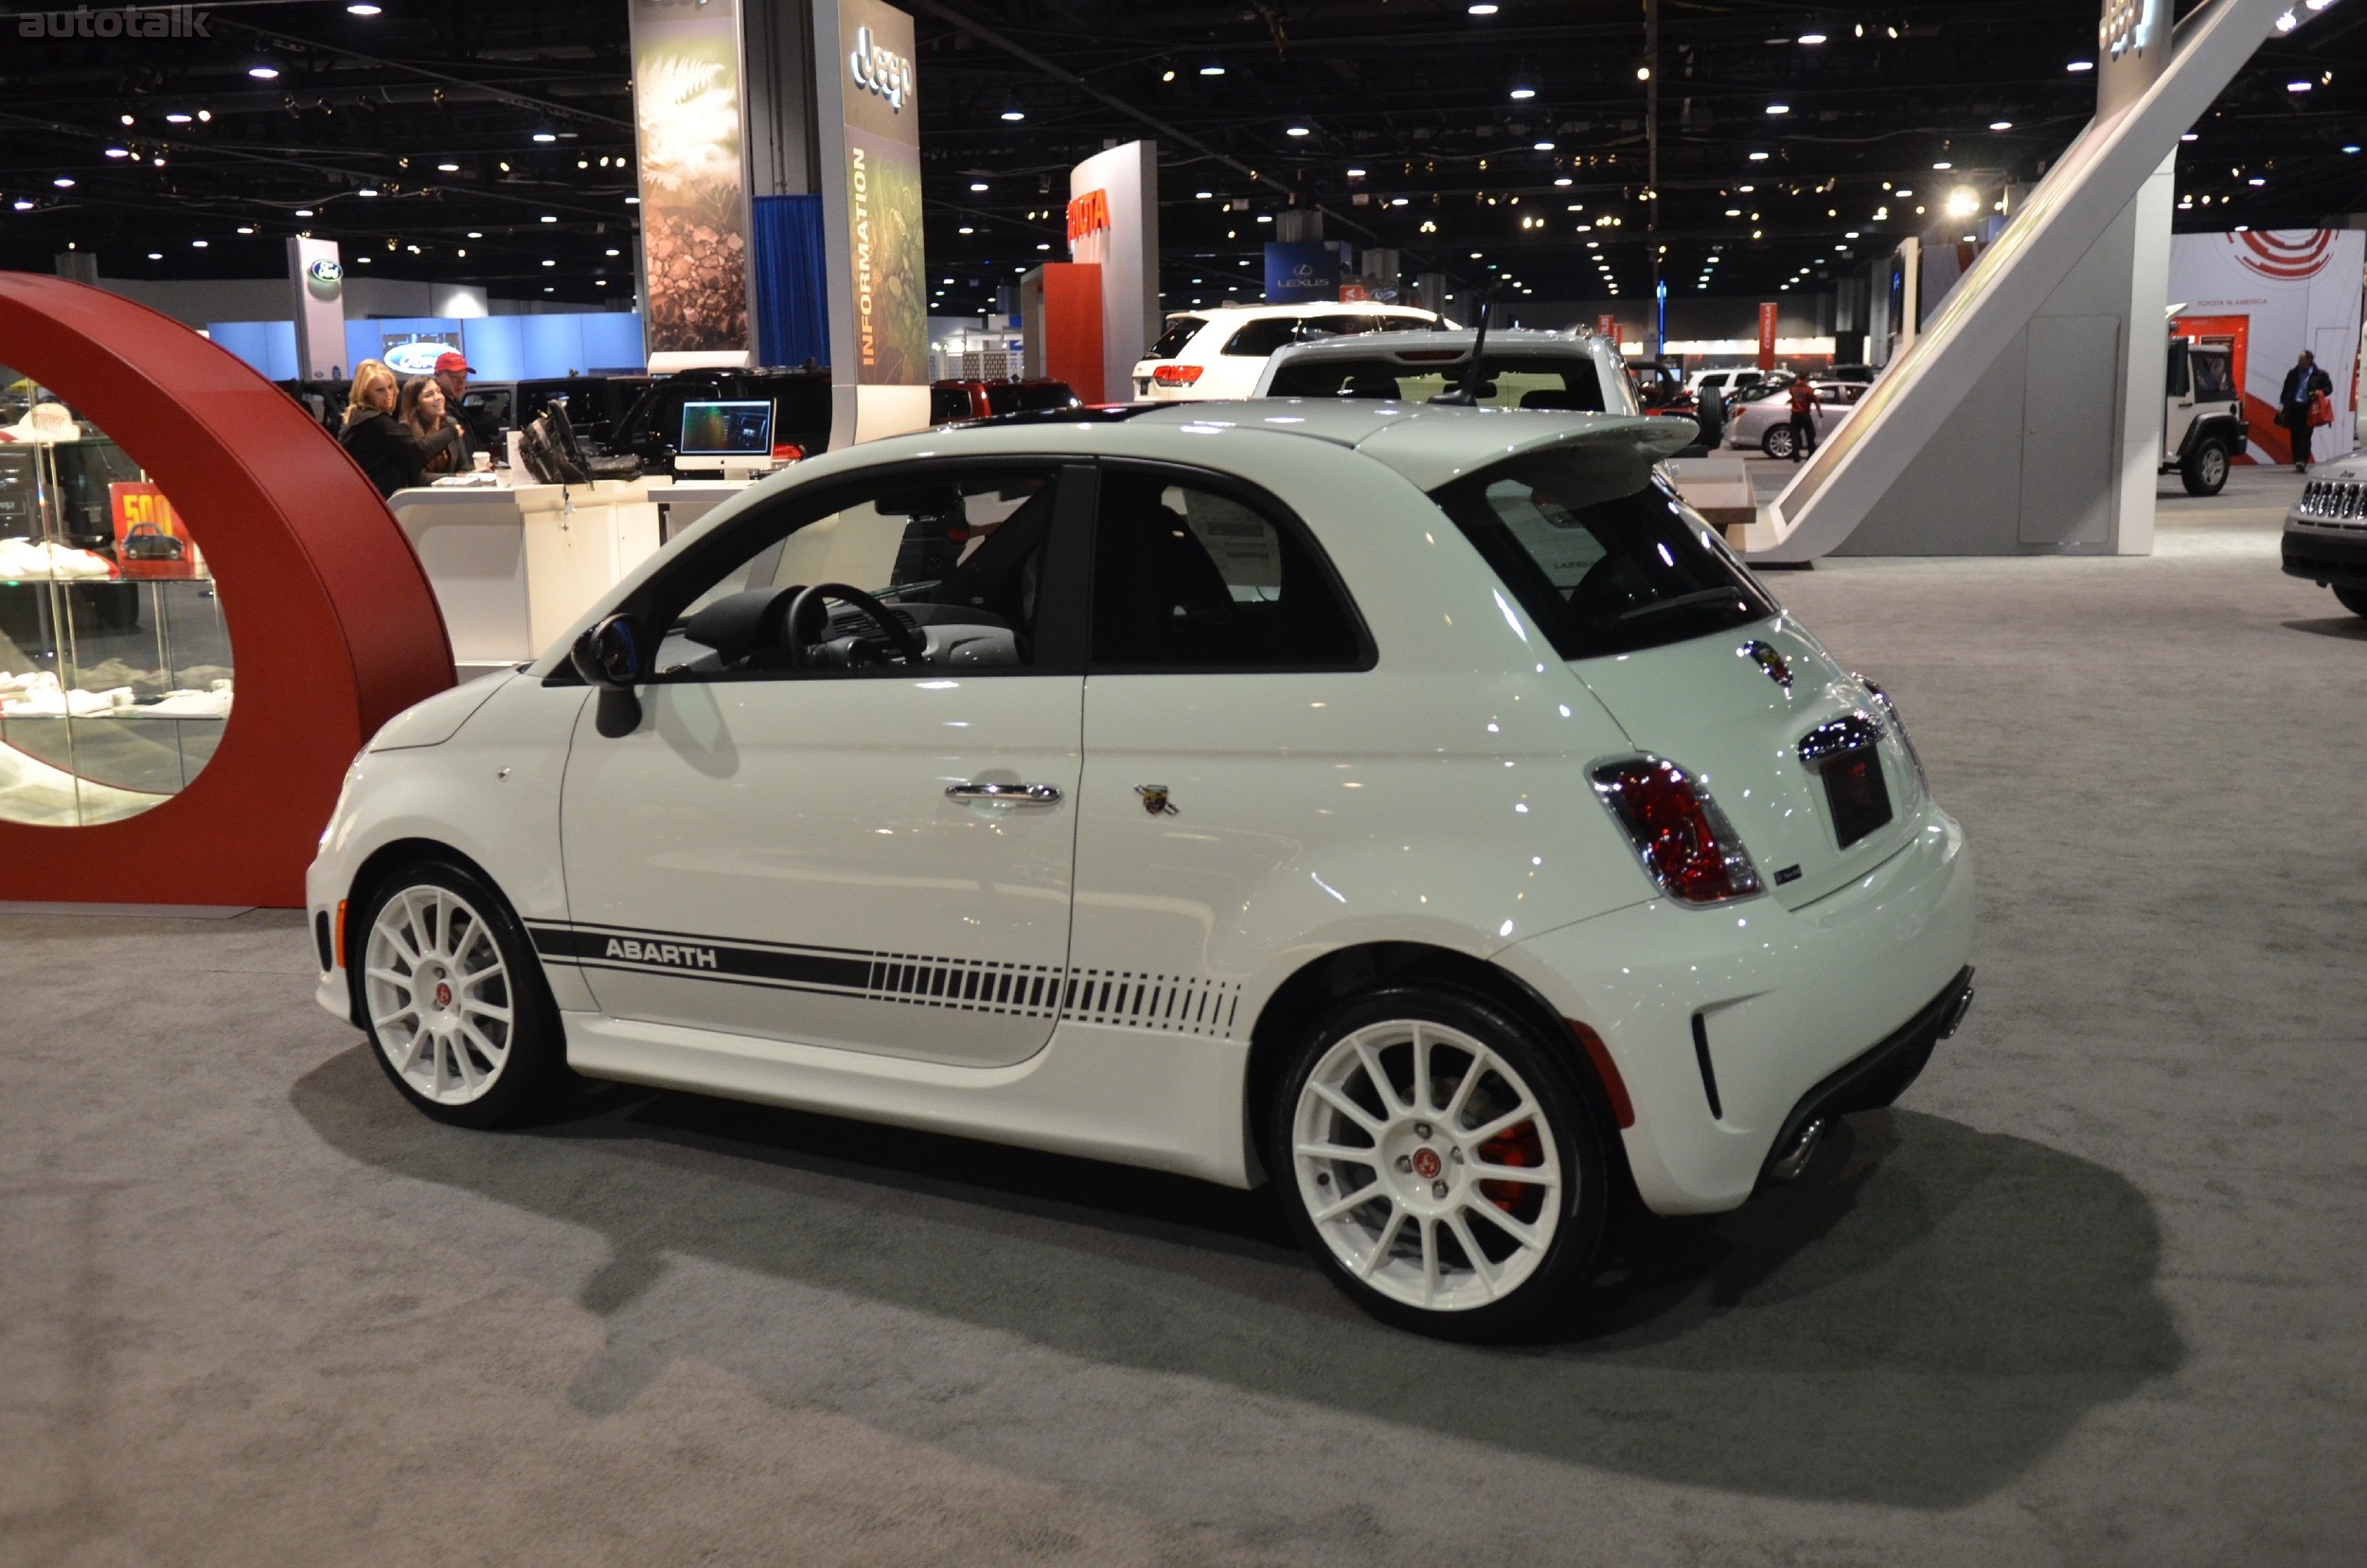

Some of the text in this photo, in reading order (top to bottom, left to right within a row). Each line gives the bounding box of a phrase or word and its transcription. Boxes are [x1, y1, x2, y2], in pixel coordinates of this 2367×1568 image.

[852, 27, 913, 108] Jeep
[853, 148, 875, 365] INFORMATION
[1277, 278, 1329, 288] LEXUS
[606, 938, 717, 968] ABARTH
